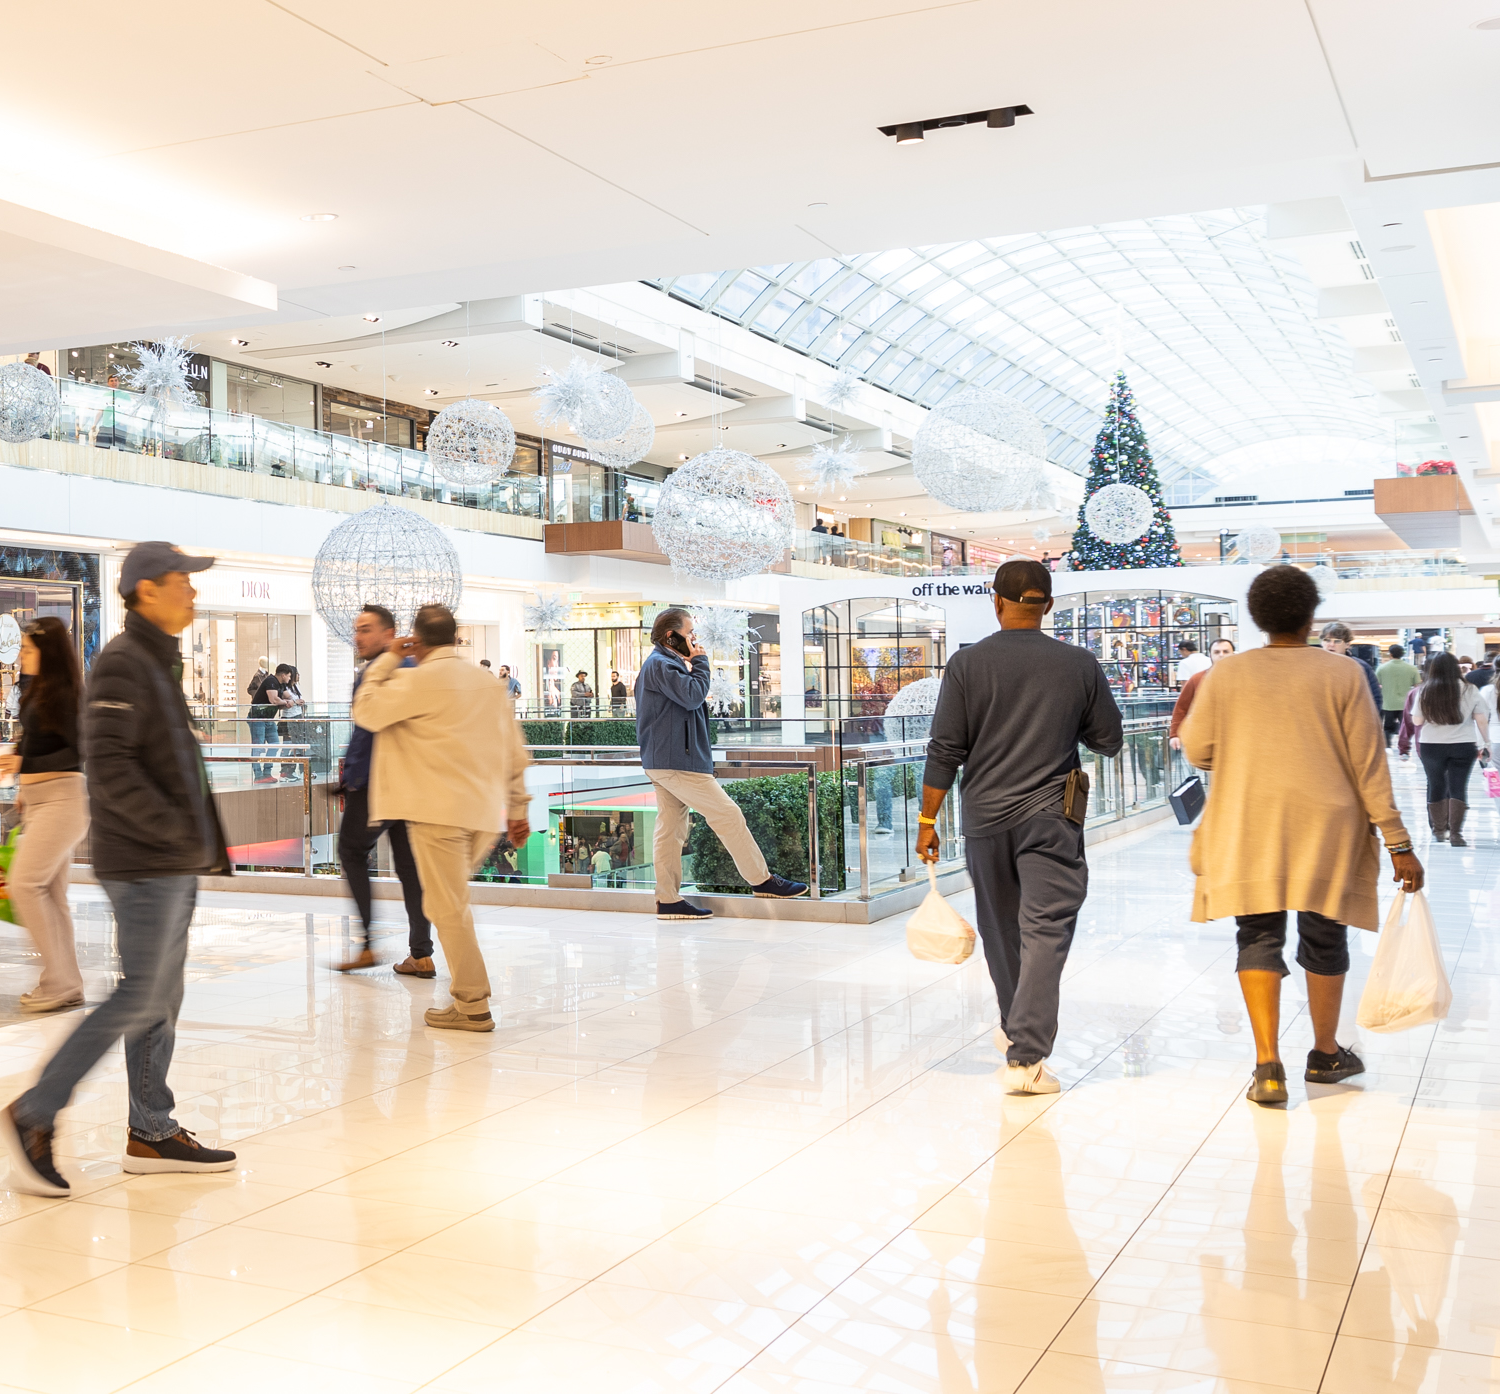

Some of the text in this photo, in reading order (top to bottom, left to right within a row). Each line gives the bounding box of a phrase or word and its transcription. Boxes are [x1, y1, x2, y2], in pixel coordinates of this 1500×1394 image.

[241, 580, 270, 600] DIOR
[912, 583, 934, 597] off
[936, 583, 960, 596] the
